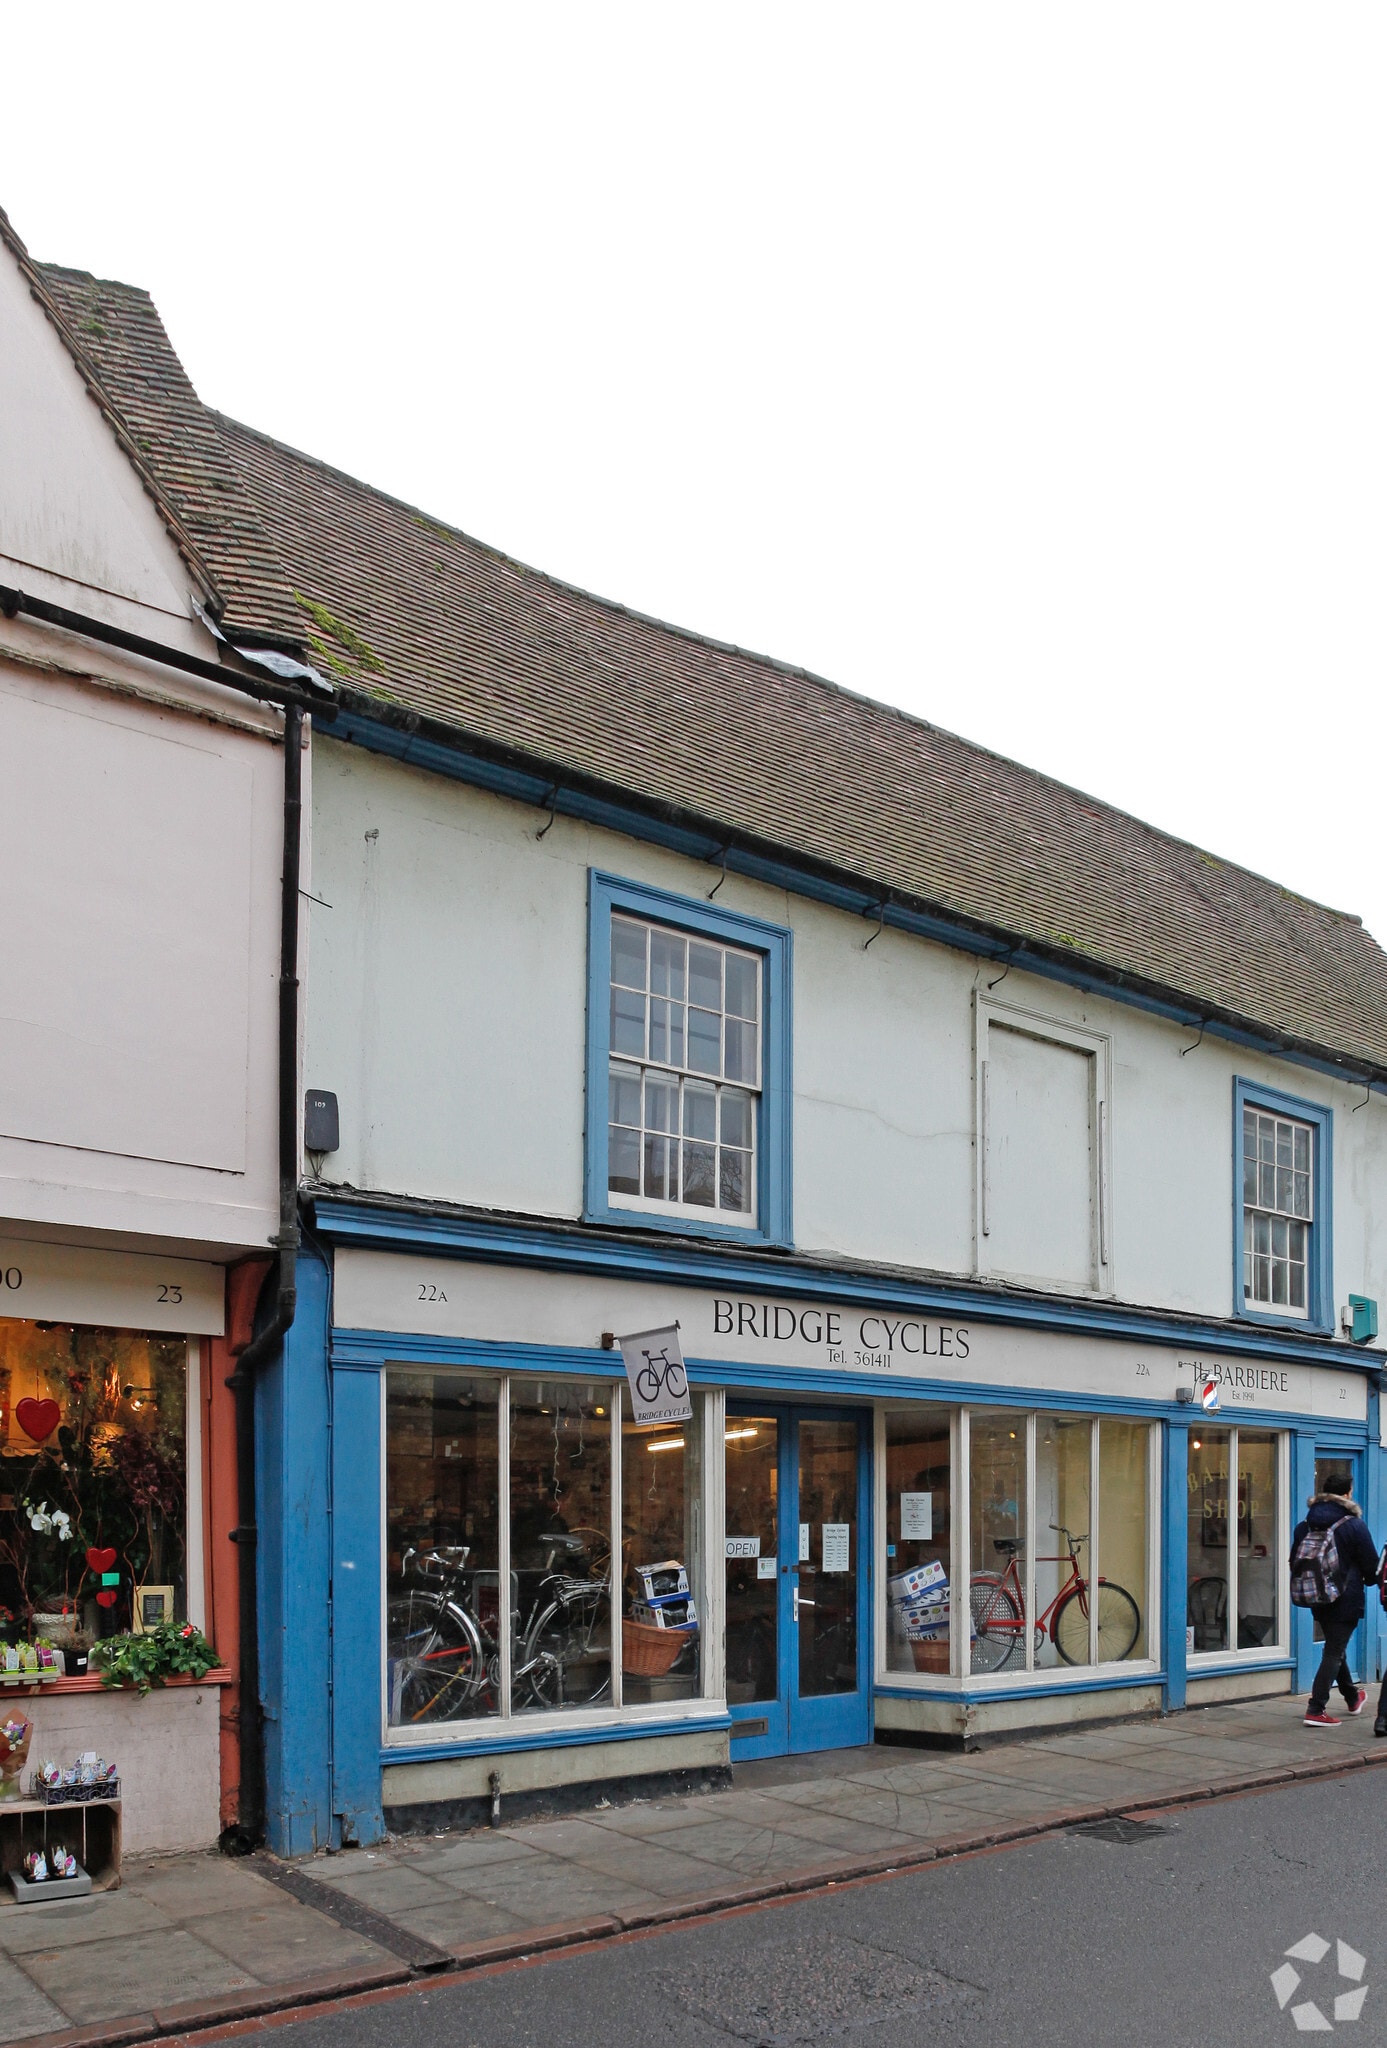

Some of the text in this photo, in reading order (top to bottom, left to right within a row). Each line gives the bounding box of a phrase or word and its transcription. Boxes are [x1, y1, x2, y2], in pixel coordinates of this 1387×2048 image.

[157, 1284, 183, 1304] 23
[418, 1284, 448, 1302] 22A
[713, 1299, 970, 1359] BRIDGE CYCLES
[827, 1348, 891, 1368] Tel. 361411
[1214, 1363, 1289, 1392] BARBIERE
[1339, 1388, 1347, 1400] 22
[1203, 1499, 1260, 1520] SHOP
[726, 1542, 756, 1555] OPEN
